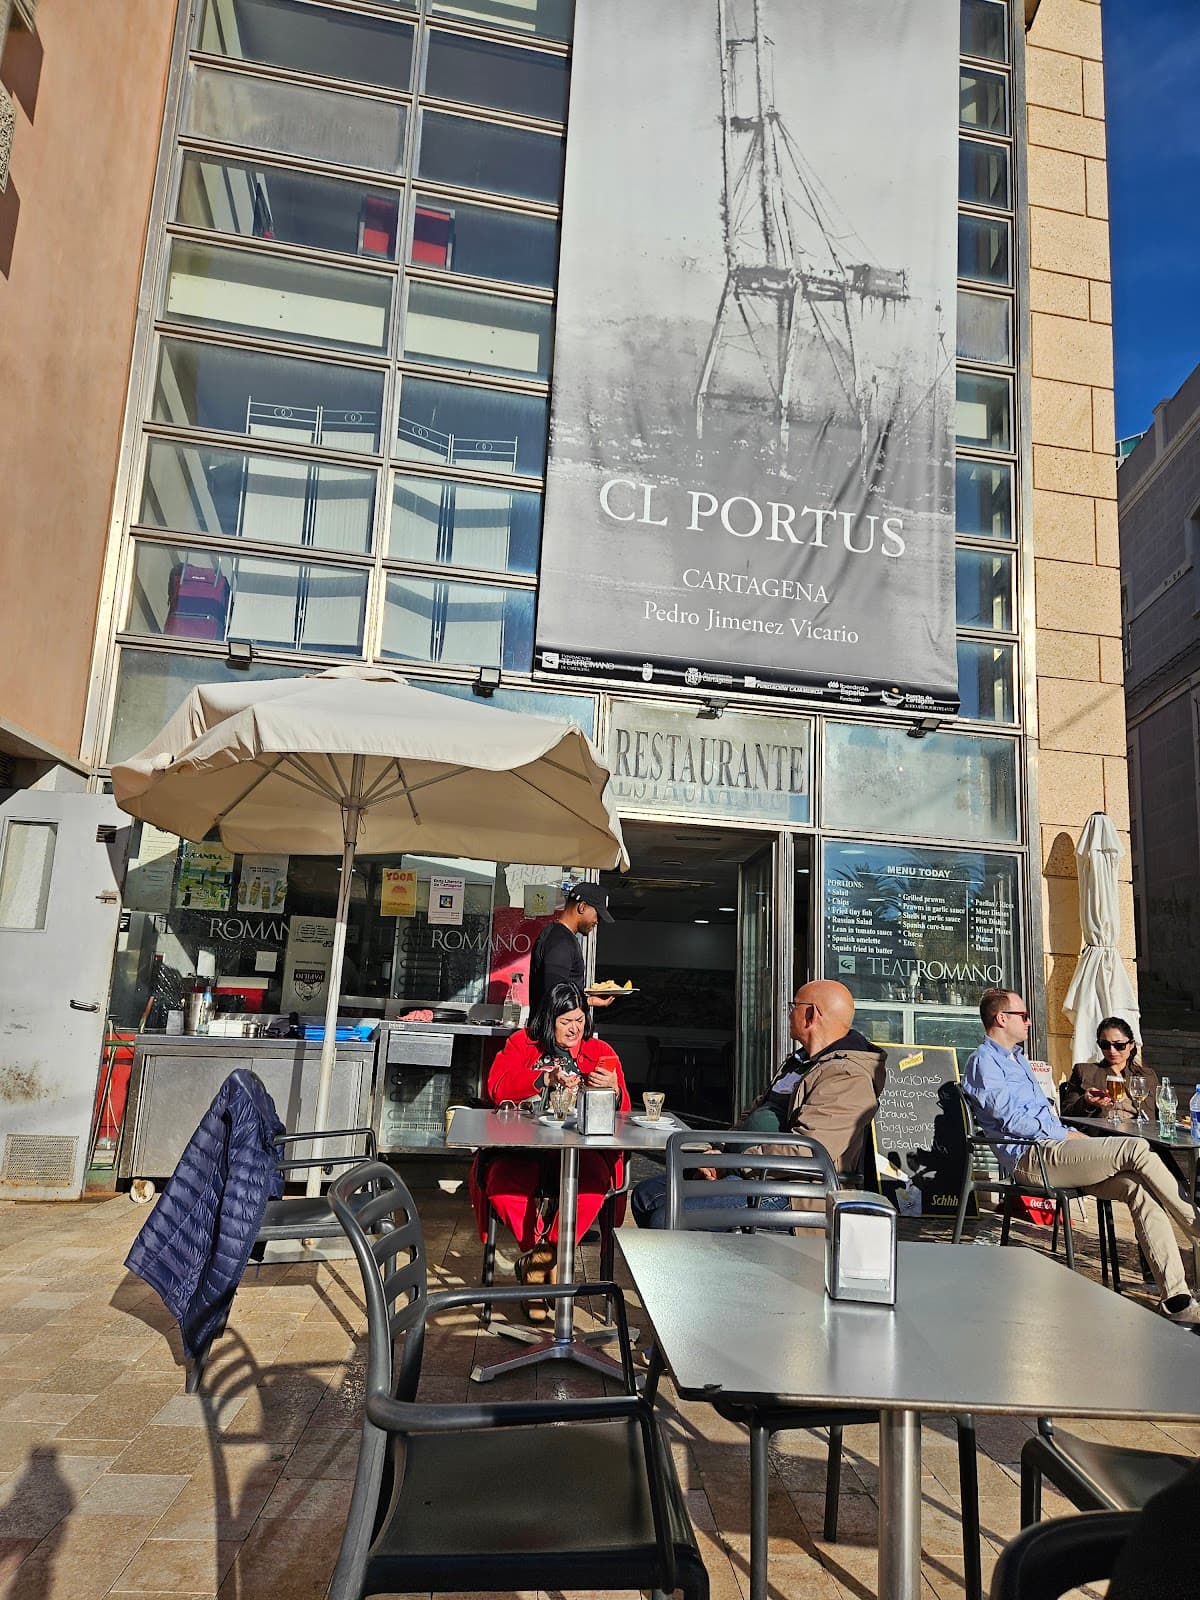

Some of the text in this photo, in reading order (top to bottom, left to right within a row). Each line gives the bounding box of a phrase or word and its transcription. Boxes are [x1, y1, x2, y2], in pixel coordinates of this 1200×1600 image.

[600, 478, 906, 558] CL PORTUS
[682, 567, 829, 605] CARTAGENA
[643, 600, 859, 644] Pedro Jimenez Vicario
[614, 728, 804, 794] RESTAURANTE
[888, 866, 951, 878] MENU TODAY
[828, 880, 864, 888] PORTIONS:
[902, 894, 923, 902] Grilled
[850, 908, 860, 916] tiny
[932, 906, 948, 914] garlic
[832, 916, 855, 924] Russian
[928, 914, 944, 923] garlic
[208, 918, 290, 941] ROMAN
[902, 921, 926, 930] Spanish
[975, 926, 993, 934] Mixed
[431, 929, 531, 954] ROMANO
[832, 934, 855, 944] Spanish
[832, 944, 852, 952] Squids
[853, 944, 867, 952] fried
[867, 957, 1002, 982] TEATROMANO
[886, 1068, 942, 1086] Raciones
[932, 1194, 958, 1206] Schhh
